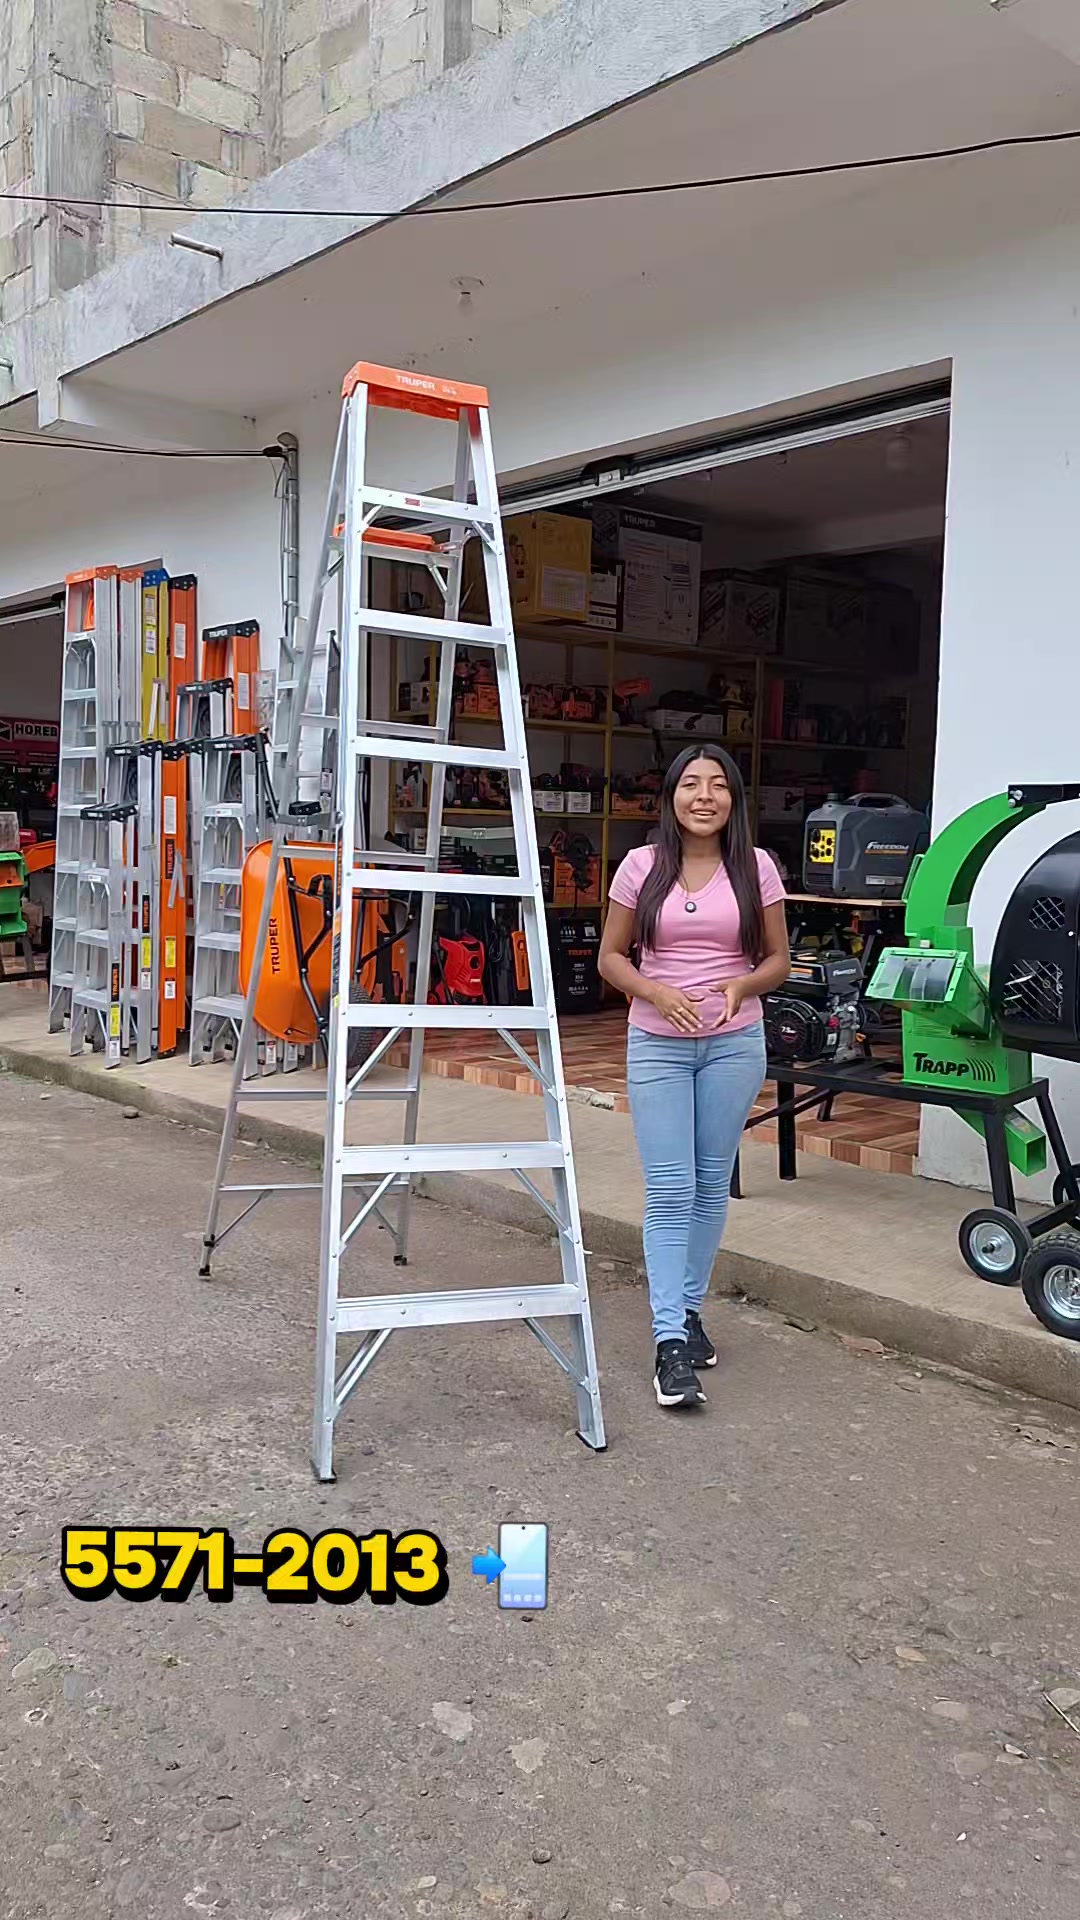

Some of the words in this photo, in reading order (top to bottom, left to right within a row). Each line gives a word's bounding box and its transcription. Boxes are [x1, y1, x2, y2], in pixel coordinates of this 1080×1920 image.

[396, 374, 435, 391] TRUPER
[15, 725, 58, 737] HOREB
[866, 841, 909, 850] FREEDOM
[269, 917, 281, 975] TRUPER
[913, 1052, 969, 1077] TRAPP
